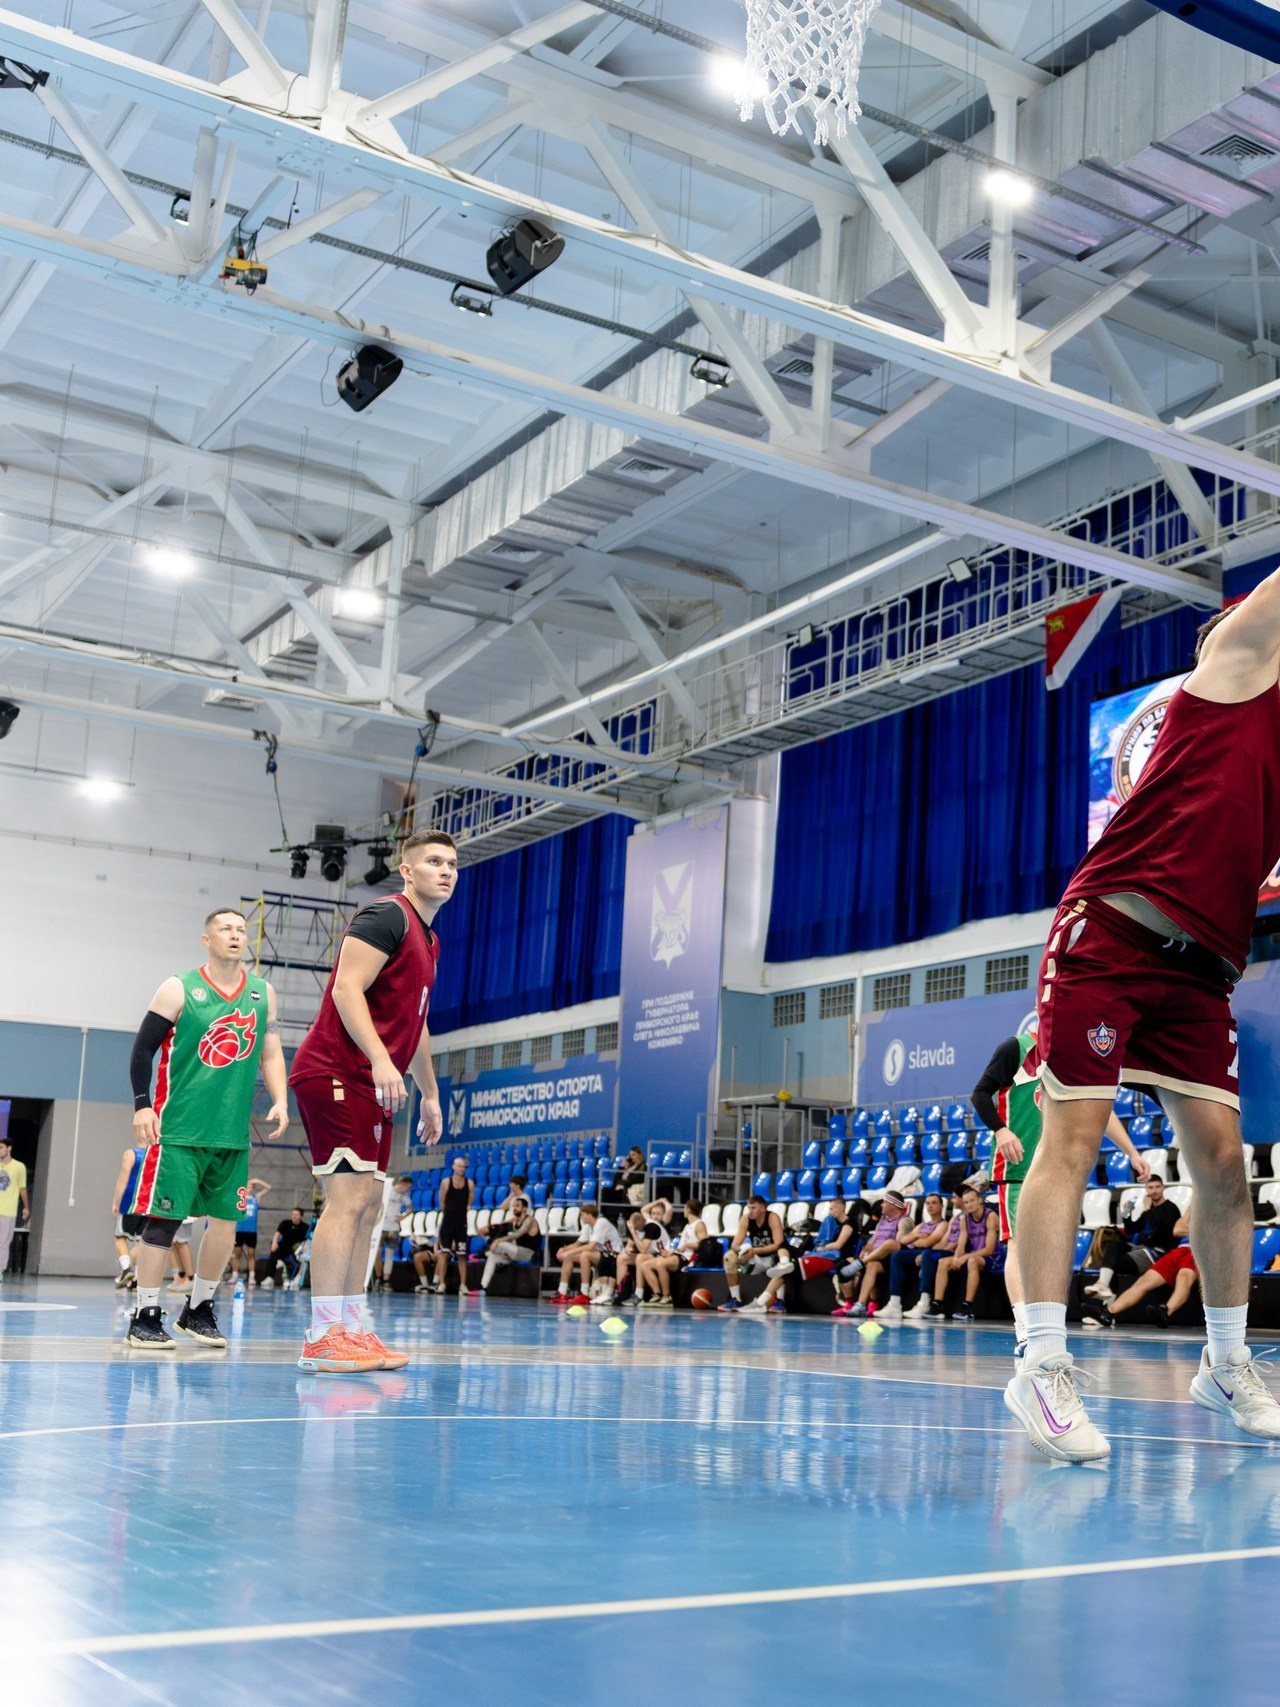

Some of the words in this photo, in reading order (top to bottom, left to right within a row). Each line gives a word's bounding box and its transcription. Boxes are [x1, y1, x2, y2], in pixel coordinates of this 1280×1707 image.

[635, 1014, 681, 1031] ПРИМОРСКОГО
[908, 1041, 955, 1069] slavda
[470, 1084, 555, 1109] МИНИСТЕРСТВО
[555, 1074, 603, 1097] СПОРТА
[469, 1103, 547, 1129] ПРИМОРСКОГО
[548, 1099, 580, 1117] КРАЯ
